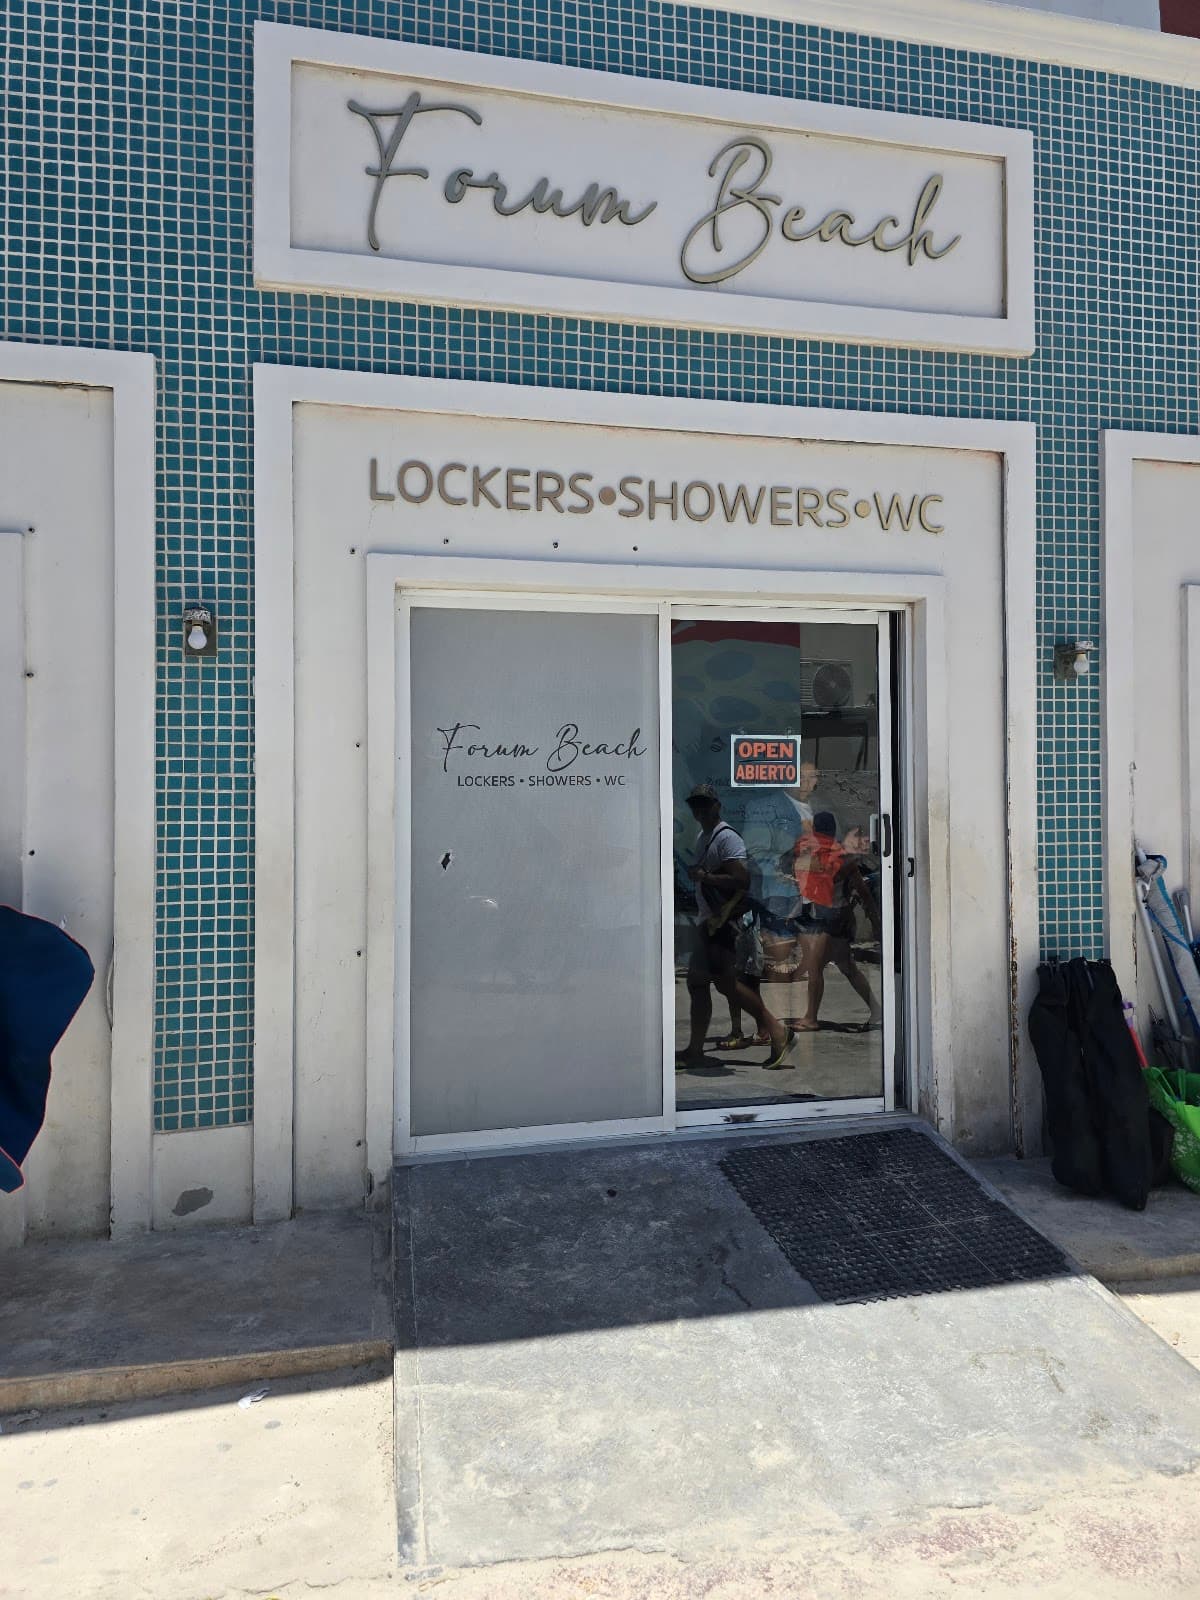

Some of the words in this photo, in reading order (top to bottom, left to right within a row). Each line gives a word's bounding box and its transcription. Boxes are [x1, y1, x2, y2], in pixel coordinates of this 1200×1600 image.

[347, 91, 659, 252] Forum
[680, 135, 962, 285] Beach
[368, 458, 595, 515] LOCKERS
[617, 476, 850, 529] SHOWERS
[873, 492, 946, 534] WC
[436, 722, 540, 773] Forum
[546, 723, 648, 772] Beach
[738, 741, 794, 759] OPEN
[457, 775, 515, 788] LOCKERS
[528, 775, 592, 787] SHOWERS
[605, 775, 626, 787] WC
[735, 763, 796, 781] ABIERTO
